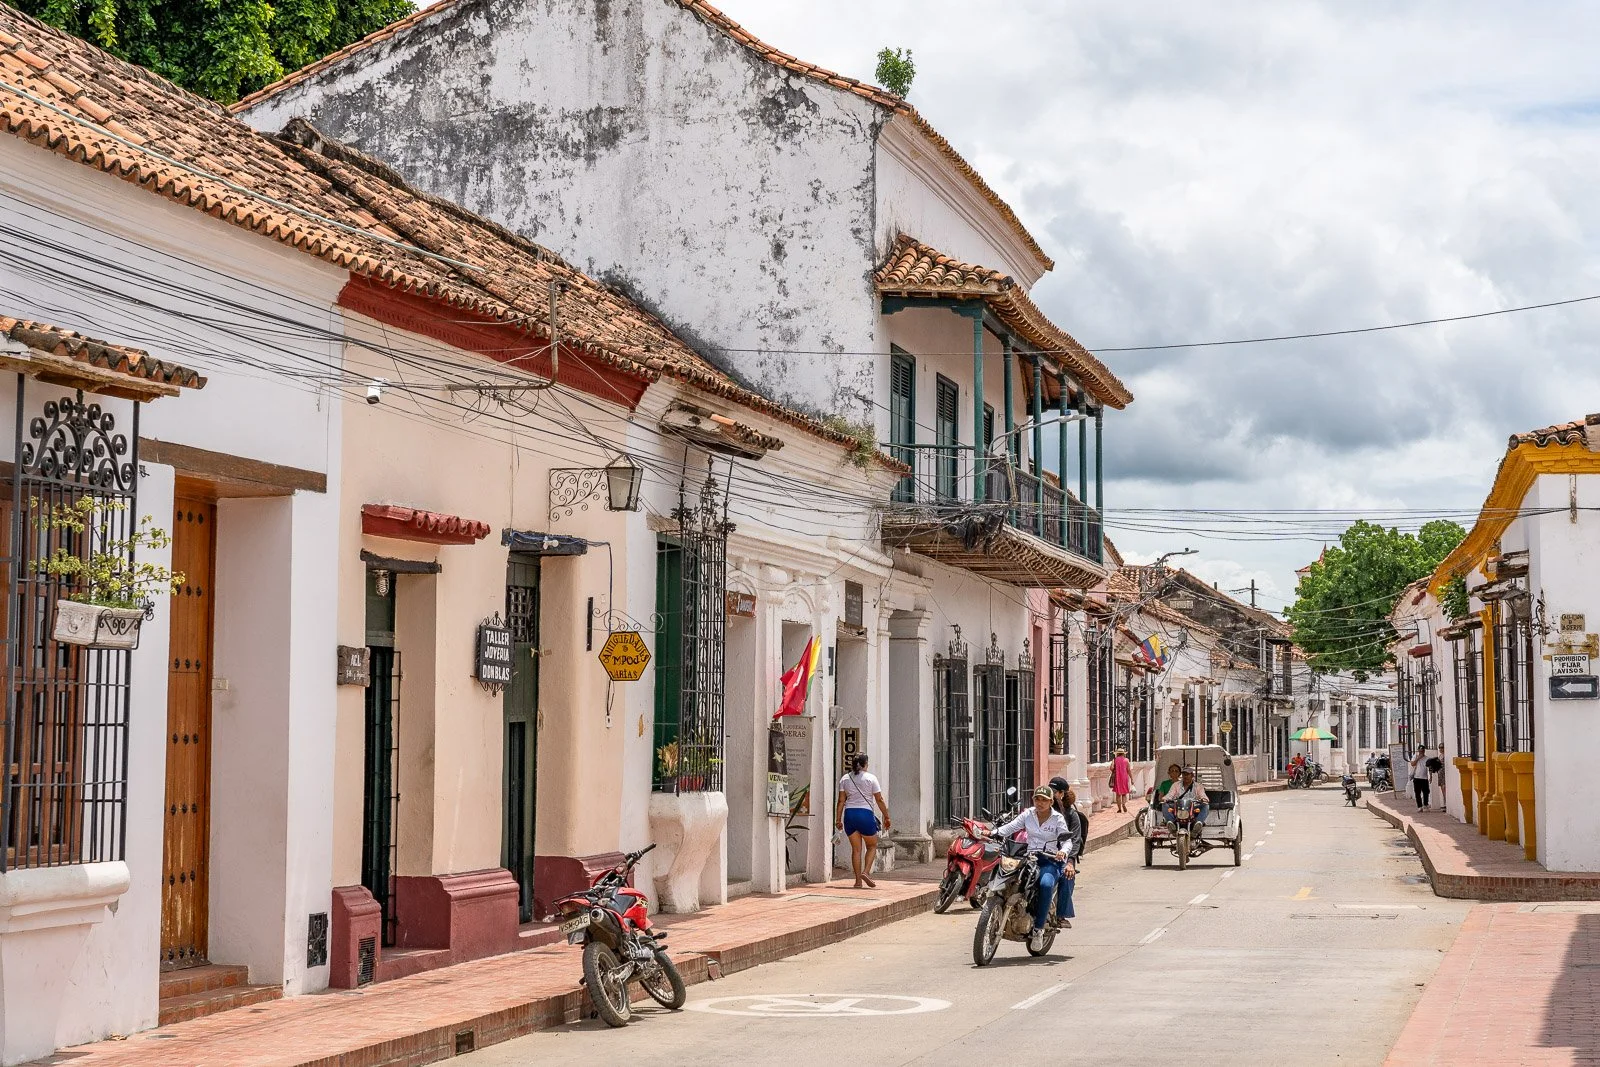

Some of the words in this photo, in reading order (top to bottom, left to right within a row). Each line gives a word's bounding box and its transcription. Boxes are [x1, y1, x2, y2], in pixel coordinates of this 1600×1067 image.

[485, 630, 510, 645] TALLER
[484, 645, 510, 661] JOYERIA
[1554, 655, 1587, 663] PROHIBIDO
